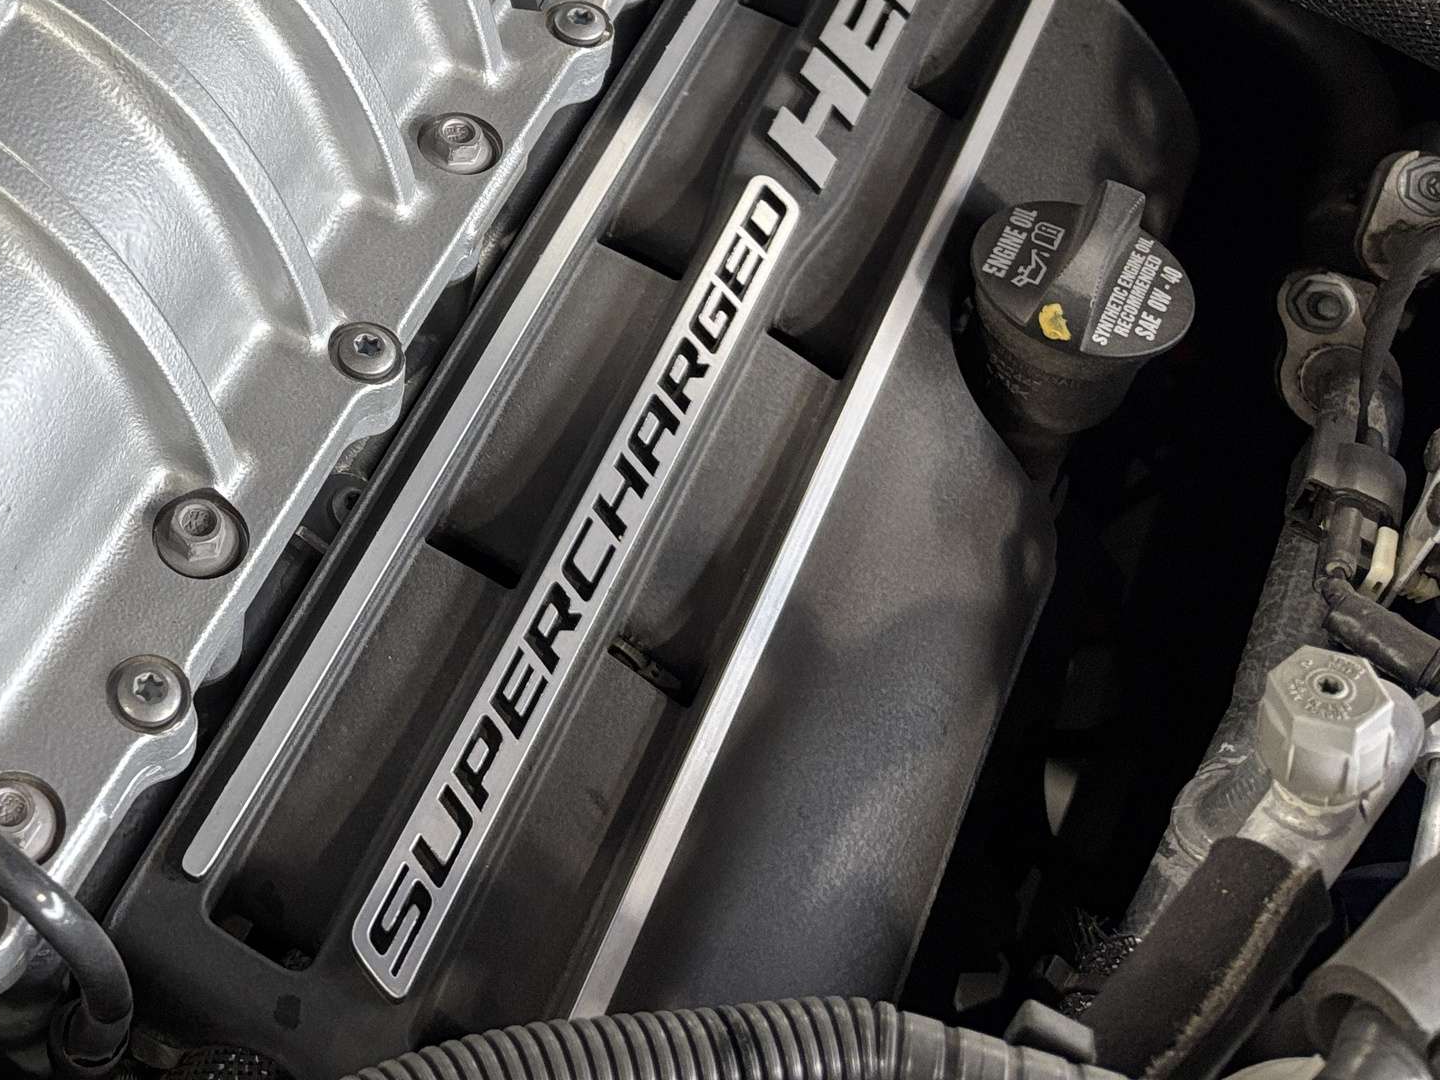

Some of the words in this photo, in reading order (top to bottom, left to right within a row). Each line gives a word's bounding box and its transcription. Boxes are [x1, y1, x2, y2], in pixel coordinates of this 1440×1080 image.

[981, 225, 1028, 278] ENGINE
[1009, 207, 1038, 229] OIL
[1092, 286, 1129, 346] SYNTHETIC
[1117, 250, 1147, 289] ENGINE
[1135, 236, 1155, 253] OIL
[1113, 254, 1162, 337] RECOMMENDED
[1134, 310, 1163, 341] SAE
[369, 184, 788, 978] SUPERCHARGED
